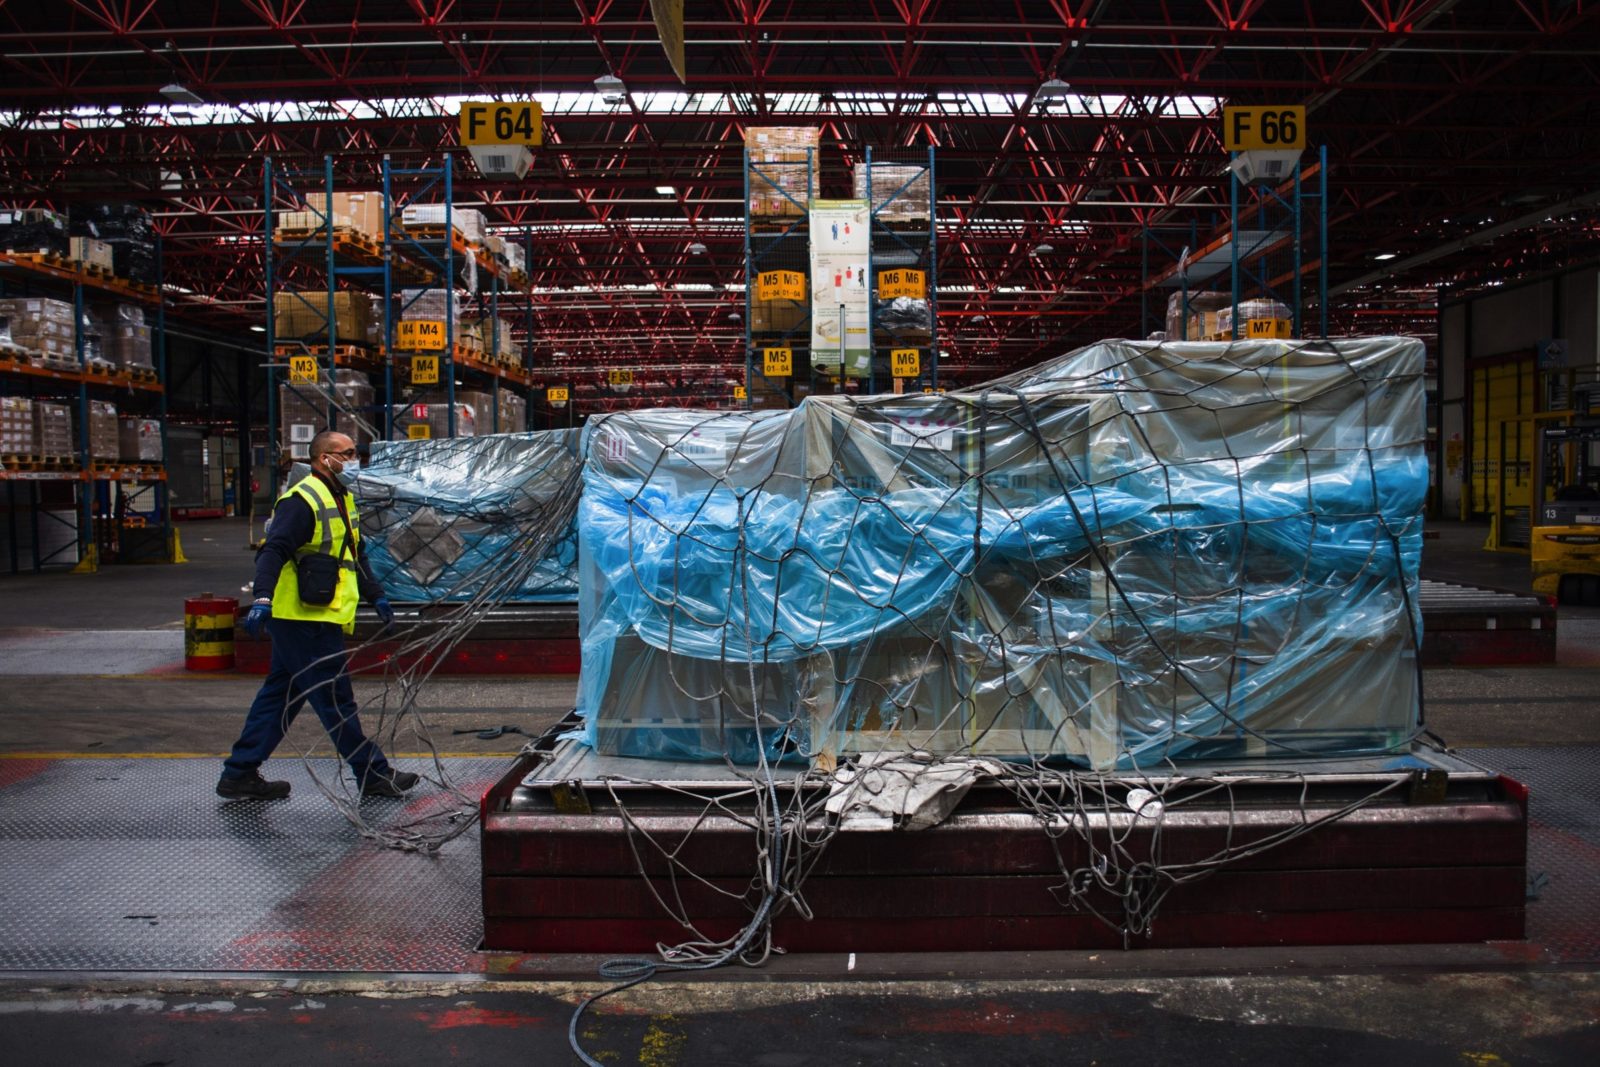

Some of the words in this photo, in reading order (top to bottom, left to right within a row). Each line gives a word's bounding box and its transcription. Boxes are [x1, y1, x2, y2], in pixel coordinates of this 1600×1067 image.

[469, 107, 487, 140] F
[495, 106, 534, 140] 64
[1233, 112, 1251, 145] F
[1261, 110, 1297, 145] 66
[763, 274, 778, 287] M5
[783, 273, 799, 286] M5
[884, 272, 899, 285] M6
[905, 271, 919, 284] M6
[419, 323, 438, 336] M4
[1253, 321, 1272, 334] M7
[769, 351, 787, 363] M5
[897, 352, 915, 365] M6
[295, 360, 314, 373] M3
[416, 359, 434, 372] M4
[556, 390, 567, 399] 52
[1545, 508, 1557, 519] 13
